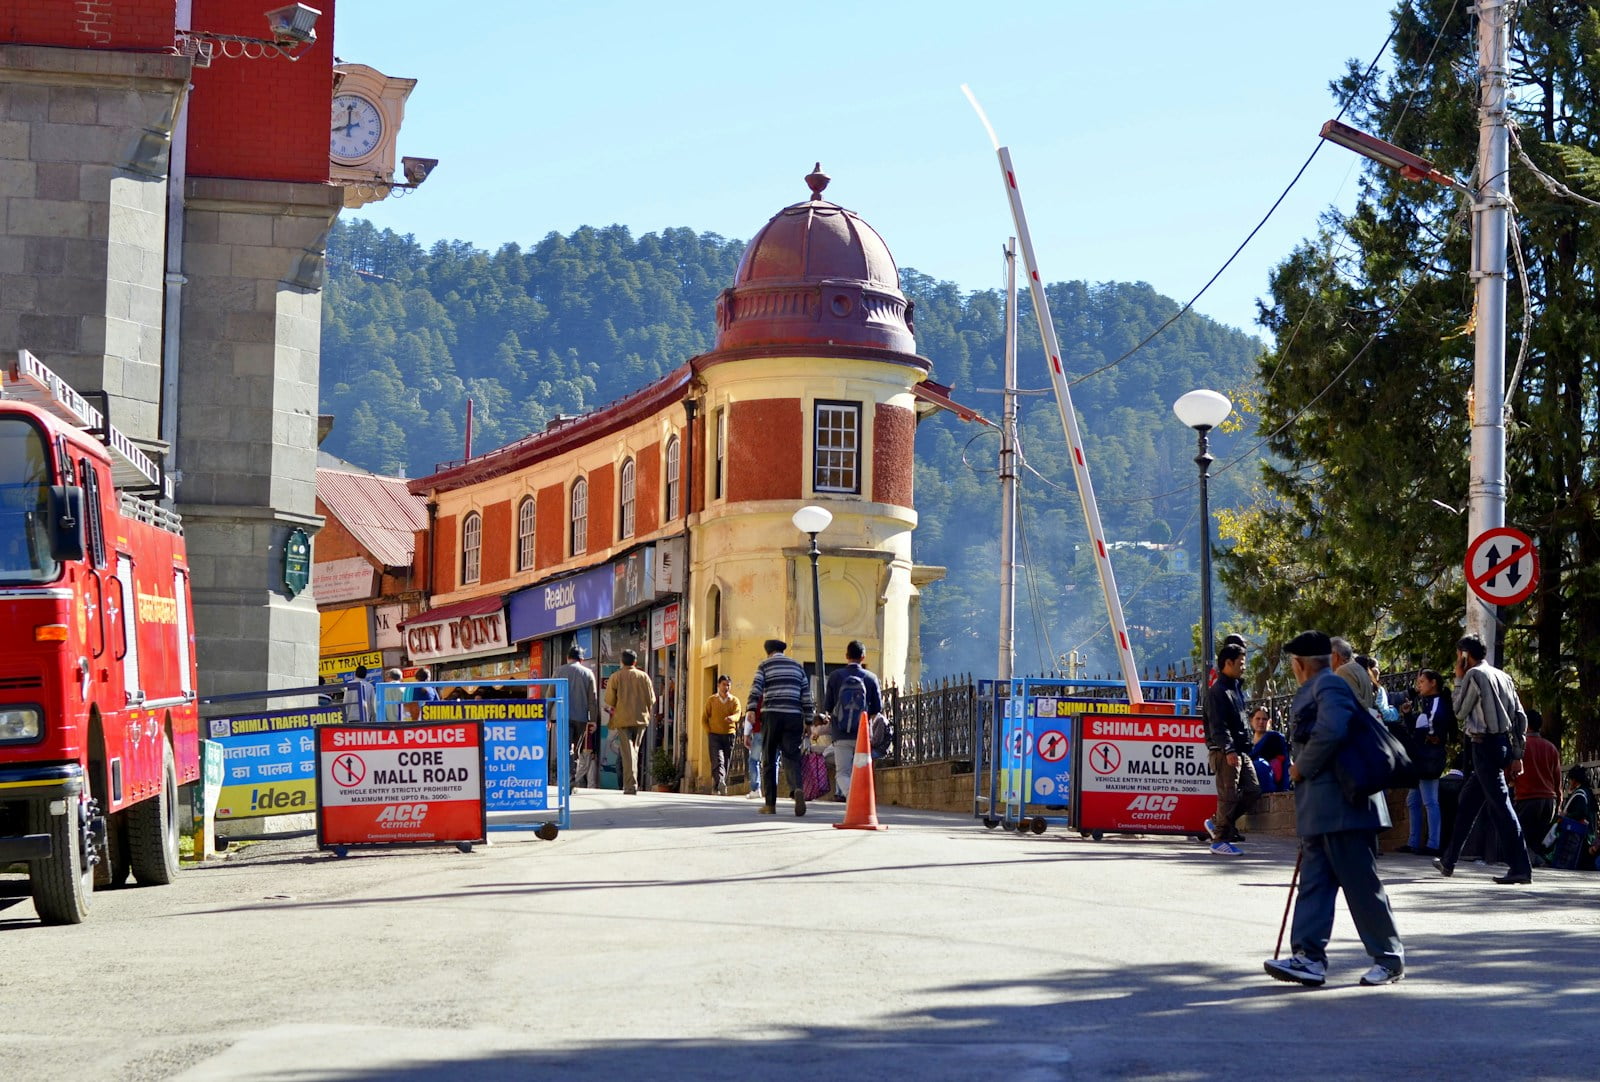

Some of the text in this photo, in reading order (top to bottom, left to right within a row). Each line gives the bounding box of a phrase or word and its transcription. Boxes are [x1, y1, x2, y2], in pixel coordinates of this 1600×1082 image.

[544, 580, 576, 610] Reebok
[408, 614, 501, 654] CITY POINT
[338, 654, 380, 668] TRAVELS
[422, 704, 544, 720] SHIMLA TRAFFIC POLICE
[1058, 701, 1130, 716] SHIMLA TRAFFI
[232, 712, 343, 734] SHIMLA TRAFFIC POLICE
[1092, 721, 1206, 738] SHIMLA POLIC
[333, 728, 466, 746] SHIMLA POLICE
[484, 726, 516, 741] ORE
[398, 751, 444, 766] CORE
[494, 746, 544, 761] ROAD
[1152, 744, 1194, 760] CORE
[488, 764, 516, 772] to Lift
[1128, 760, 1169, 775] MALL
[374, 768, 468, 784] MALL ROAD
[492, 788, 544, 799] of Patiala
[1126, 795, 1179, 812] ACC
[375, 804, 428, 822] ACC
[1131, 811, 1172, 820] cement
[380, 819, 422, 829] cement
